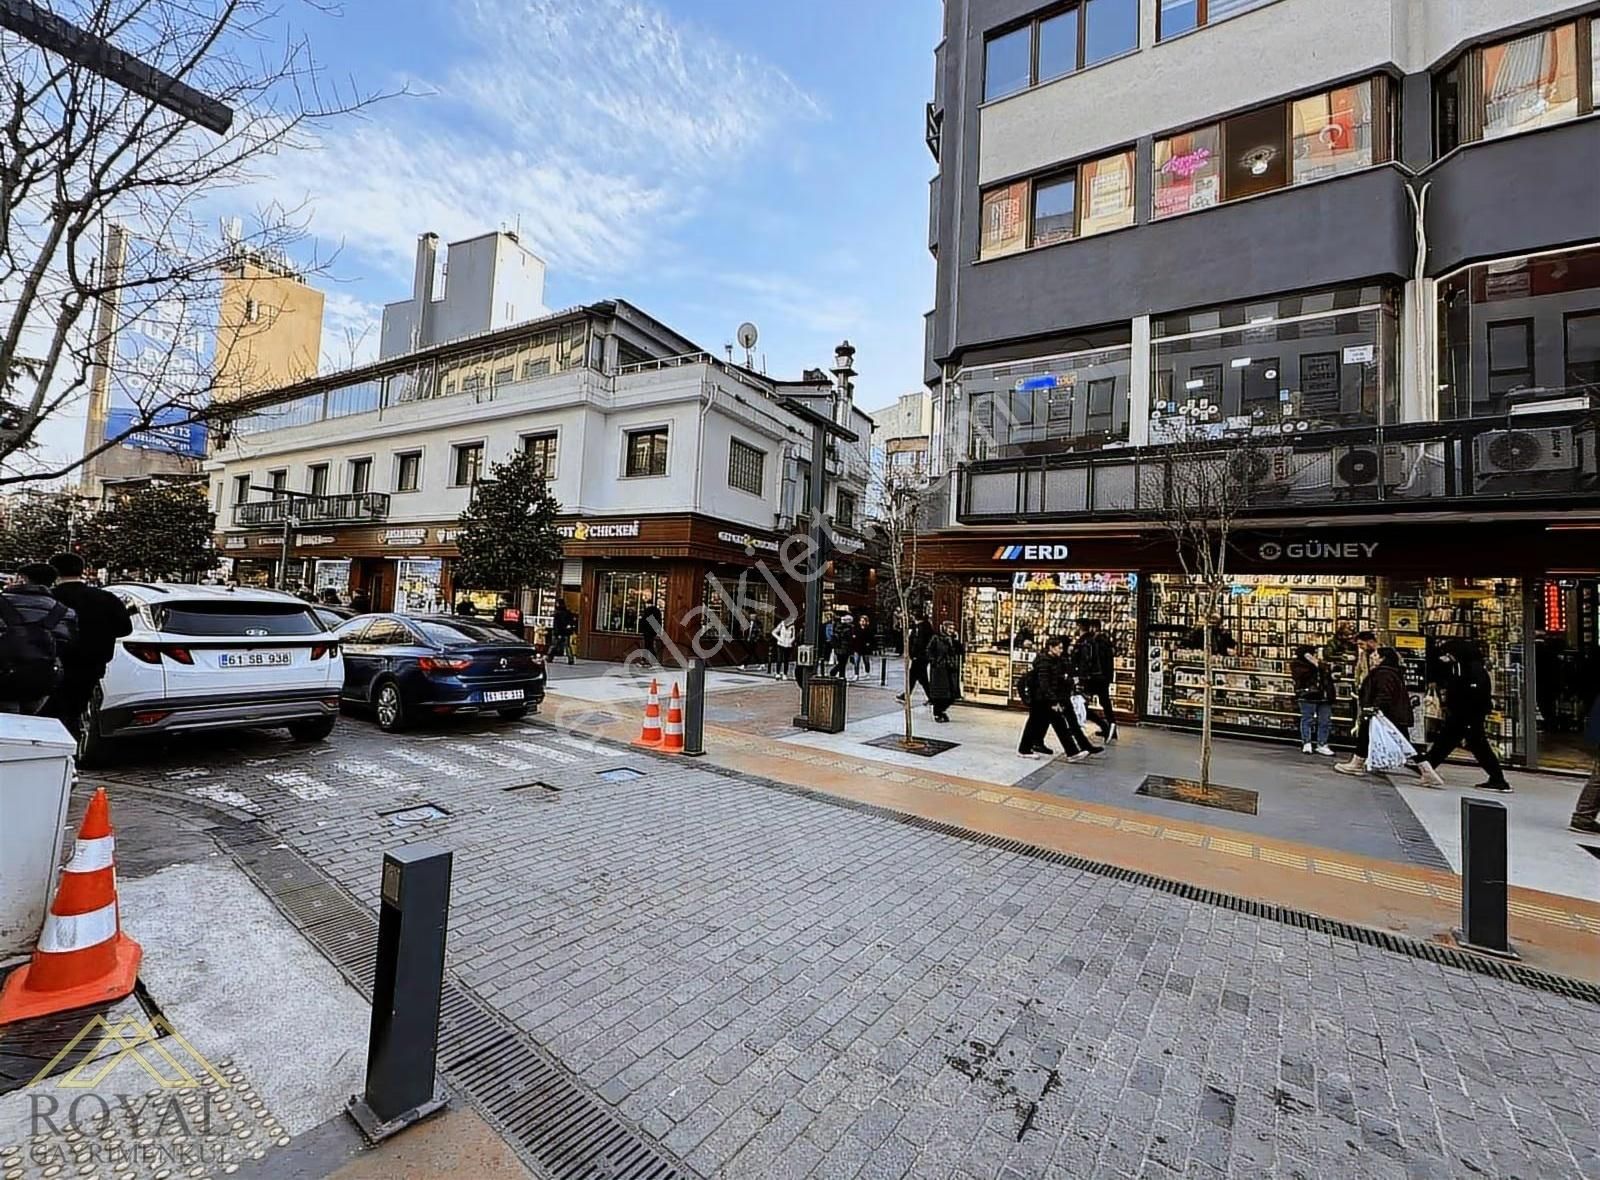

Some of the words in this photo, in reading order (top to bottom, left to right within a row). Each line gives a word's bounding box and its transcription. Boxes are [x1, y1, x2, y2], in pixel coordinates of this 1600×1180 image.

[590, 523, 639, 537] CHICKEN
[1024, 545, 1068, 560] ERD
[1287, 540, 1379, 557] GÜNEY
[228, 655, 242, 665] 61
